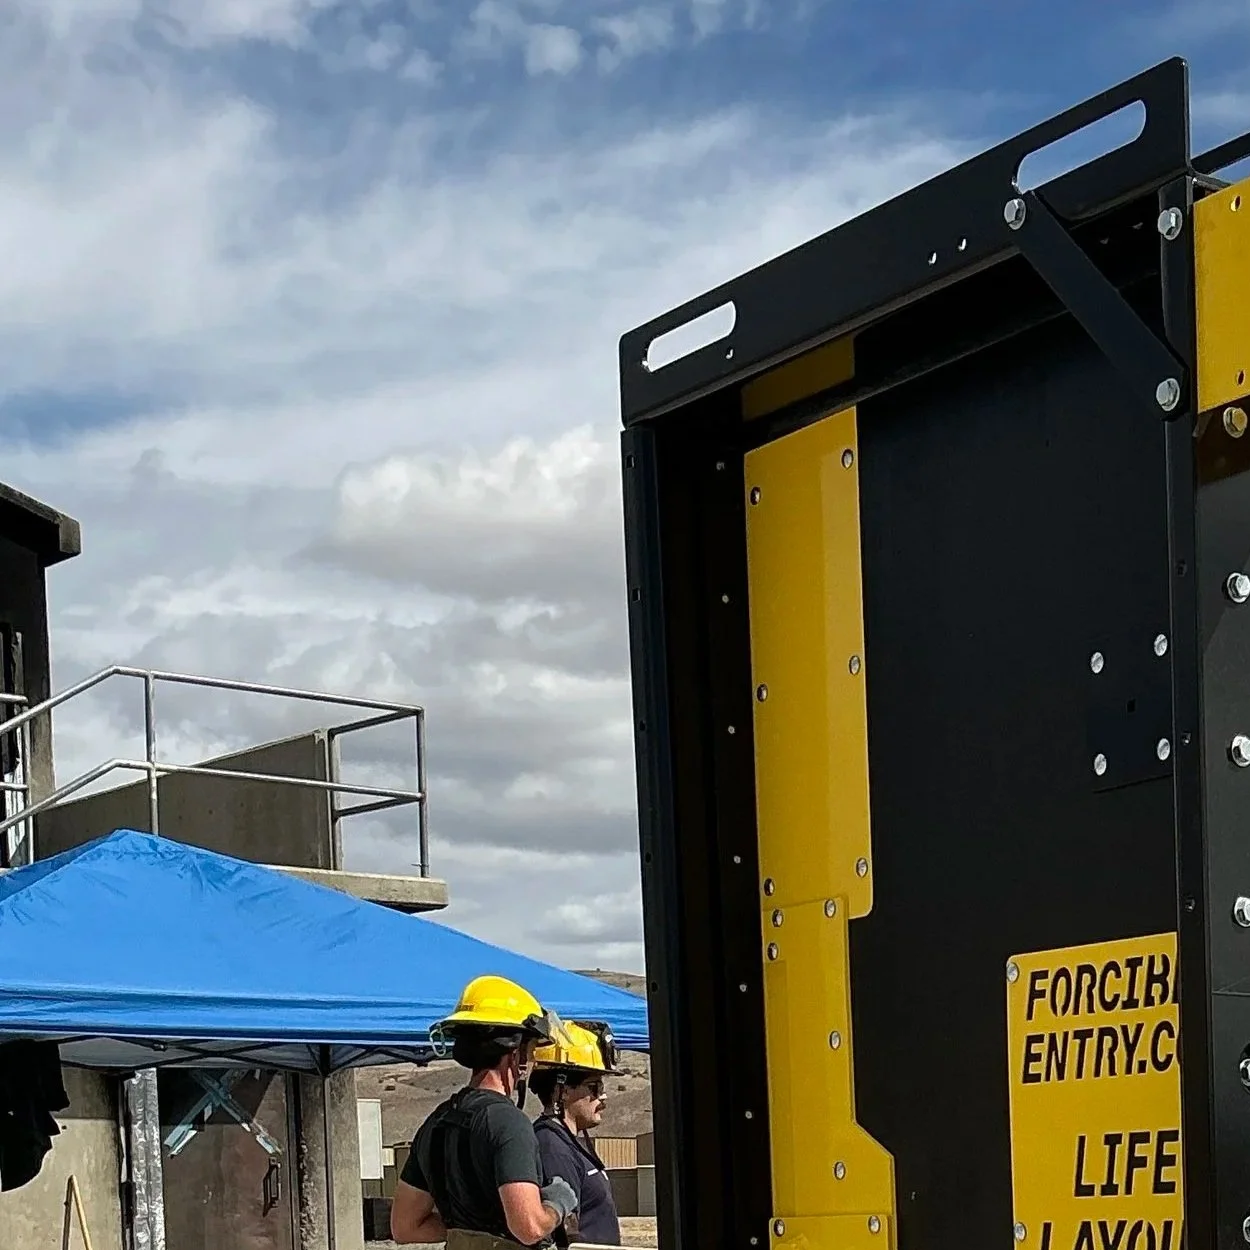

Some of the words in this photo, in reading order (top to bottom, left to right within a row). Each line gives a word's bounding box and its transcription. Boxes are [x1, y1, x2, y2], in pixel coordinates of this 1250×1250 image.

[1026, 953, 1180, 1021] FORCIB
[1021, 1020, 1181, 1084] ENTRY.C
[1074, 1129, 1180, 1197] LIFE
